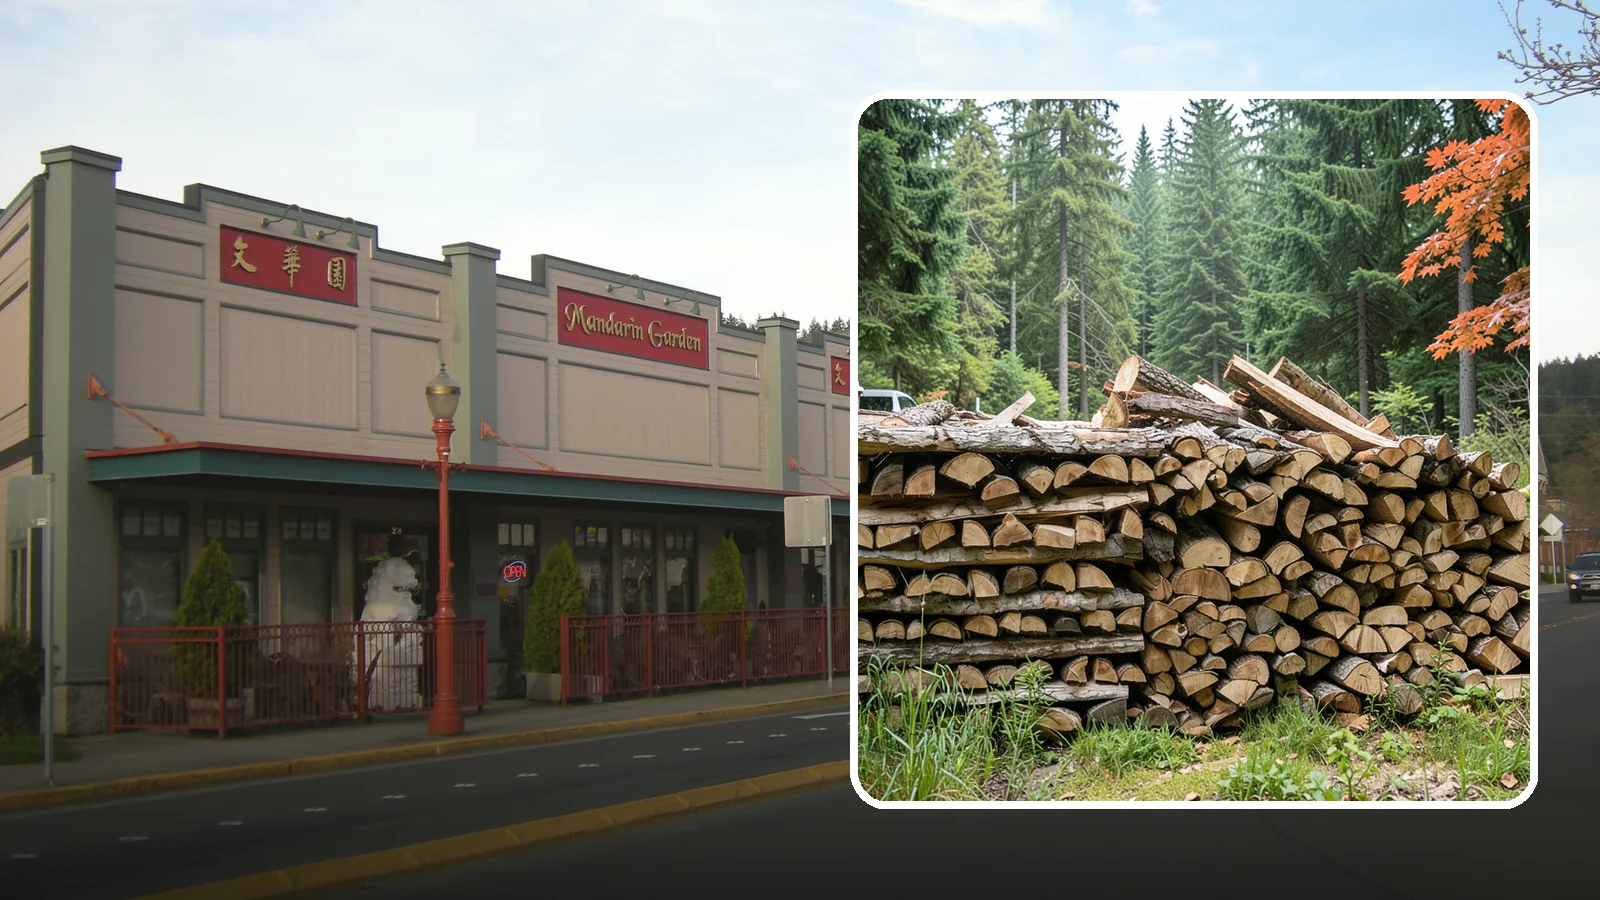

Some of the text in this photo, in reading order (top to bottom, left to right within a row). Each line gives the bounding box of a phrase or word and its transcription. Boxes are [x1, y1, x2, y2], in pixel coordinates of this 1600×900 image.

[230, 235, 346, 291] 文華園
[564, 302, 701, 352] Mandarin Garden
[503, 565, 527, 578] OPEN
